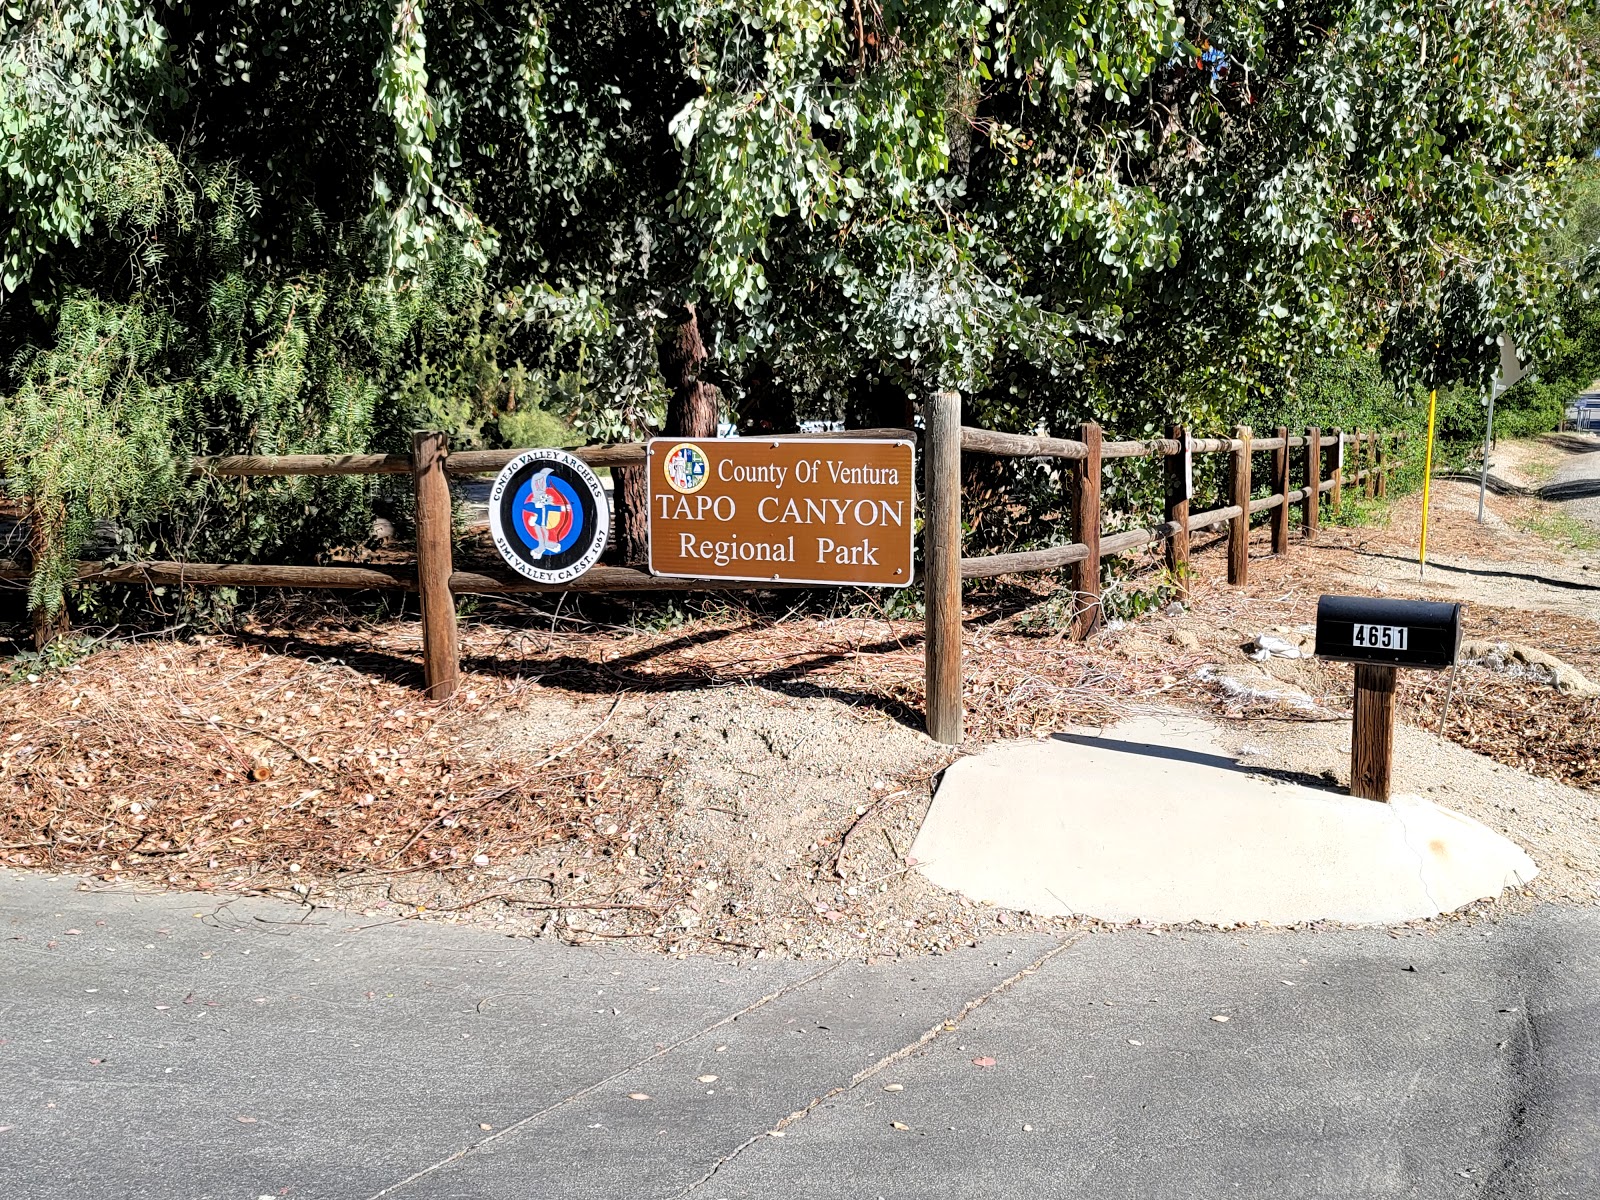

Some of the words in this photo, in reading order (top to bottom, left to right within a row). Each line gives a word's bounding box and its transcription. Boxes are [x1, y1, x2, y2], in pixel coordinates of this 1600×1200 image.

[493, 462, 519, 501] CONEJO
[519, 451, 560, 464] VALLEY
[562, 455, 602, 498] ARCHERS
[718, 459, 788, 489] County
[795, 459, 821, 484] Of
[826, 460, 899, 485] Ventura
[655, 494, 736, 522] TAPO
[757, 496, 904, 527] CANYON
[497, 537, 514, 562] SIMI
[515, 559, 557, 582] VALLEY,
[558, 570, 573, 580] CA
[574, 555, 594, 573] EST.
[593, 529, 606, 555] 1967
[678, 532, 795, 566] Regional
[816, 537, 880, 566] Park
[1355, 625, 1404, 649] 4651
